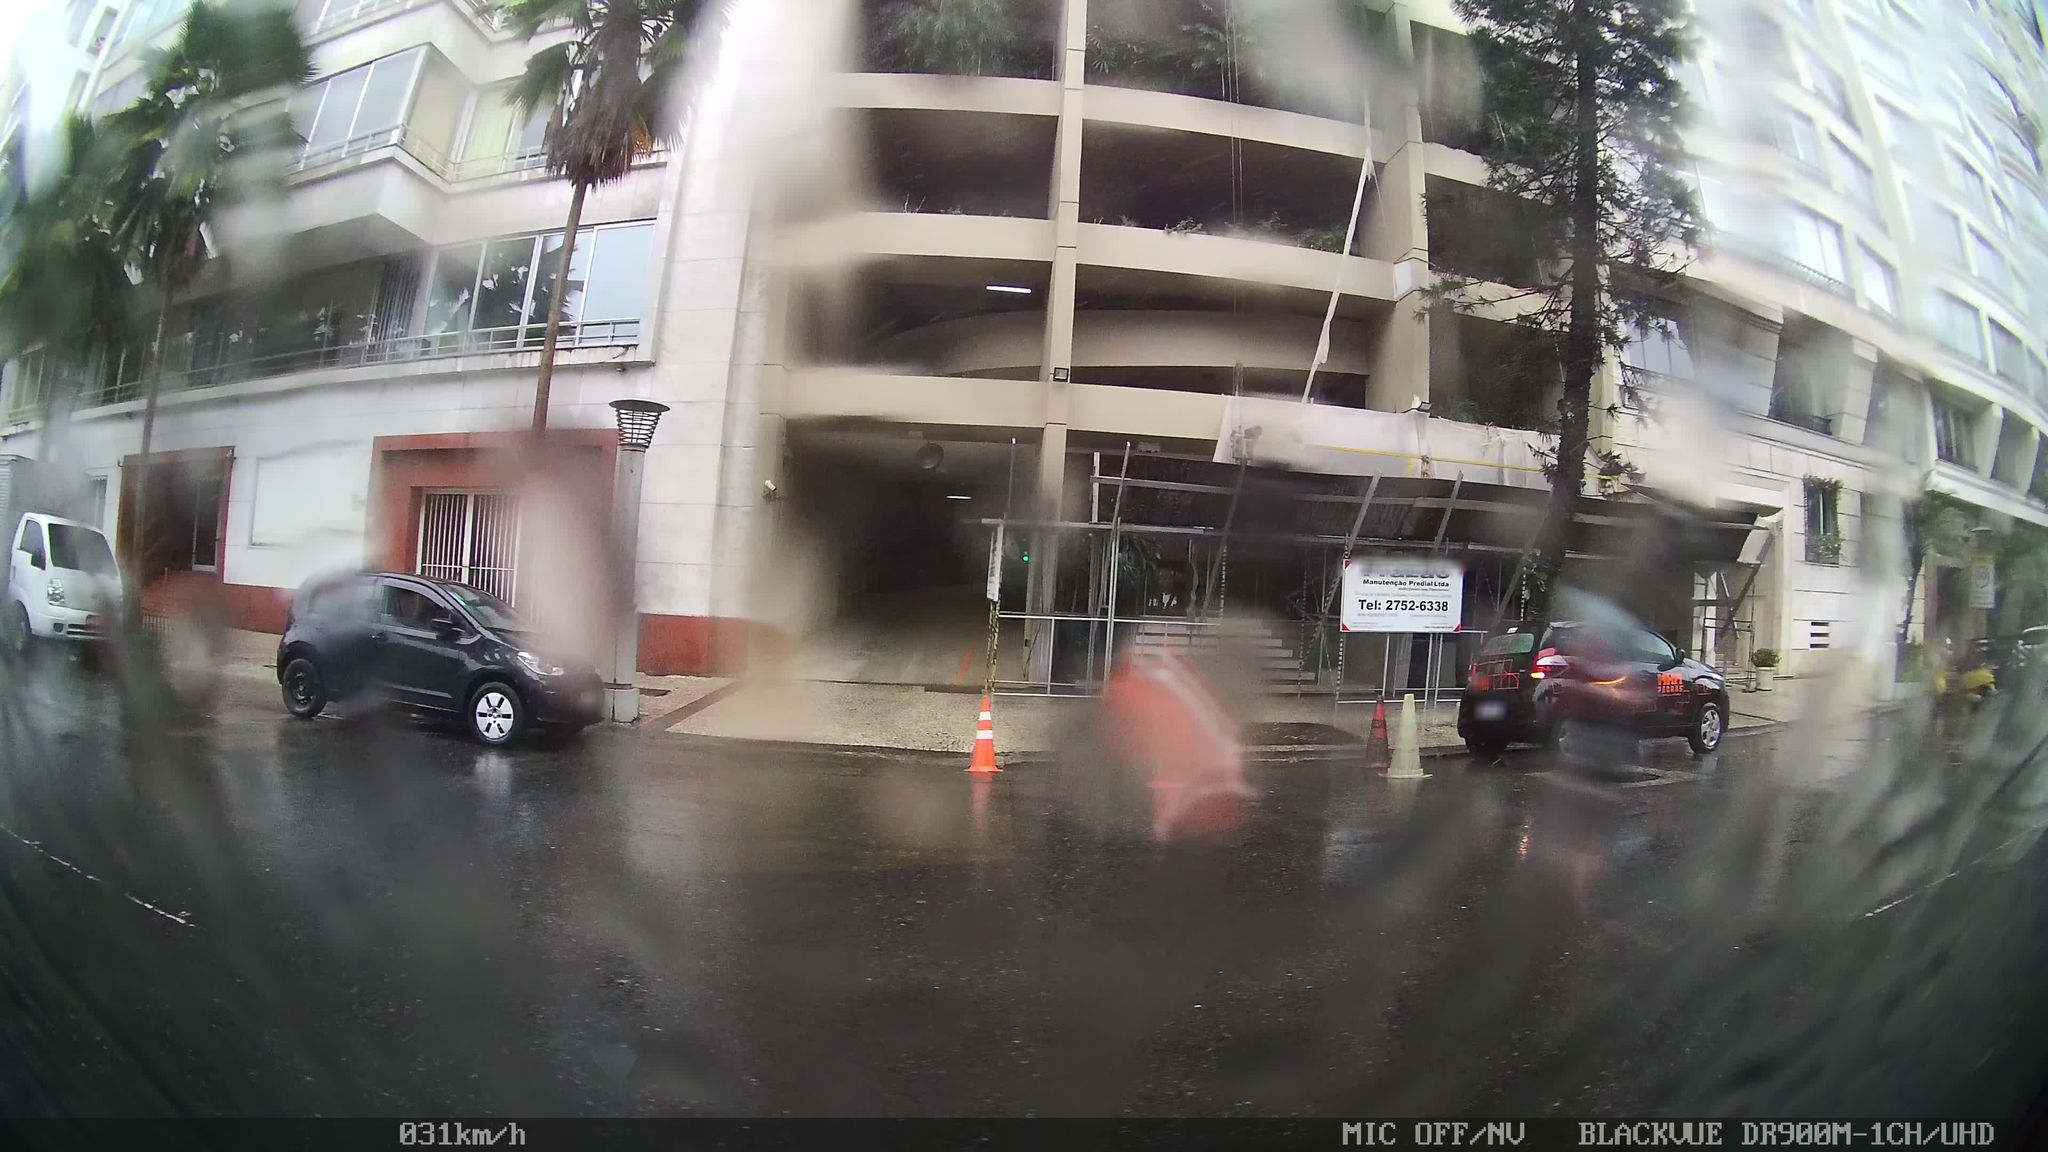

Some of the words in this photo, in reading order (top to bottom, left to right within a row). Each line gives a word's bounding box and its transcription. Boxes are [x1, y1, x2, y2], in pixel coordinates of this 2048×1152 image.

[1362, 579, 1407, 587] Manutenção
[1408, 580, 1433, 588] Predial
[1358, 599, 1382, 611] Tel:
[1385, 599, 1449, 612] 2752-6338
